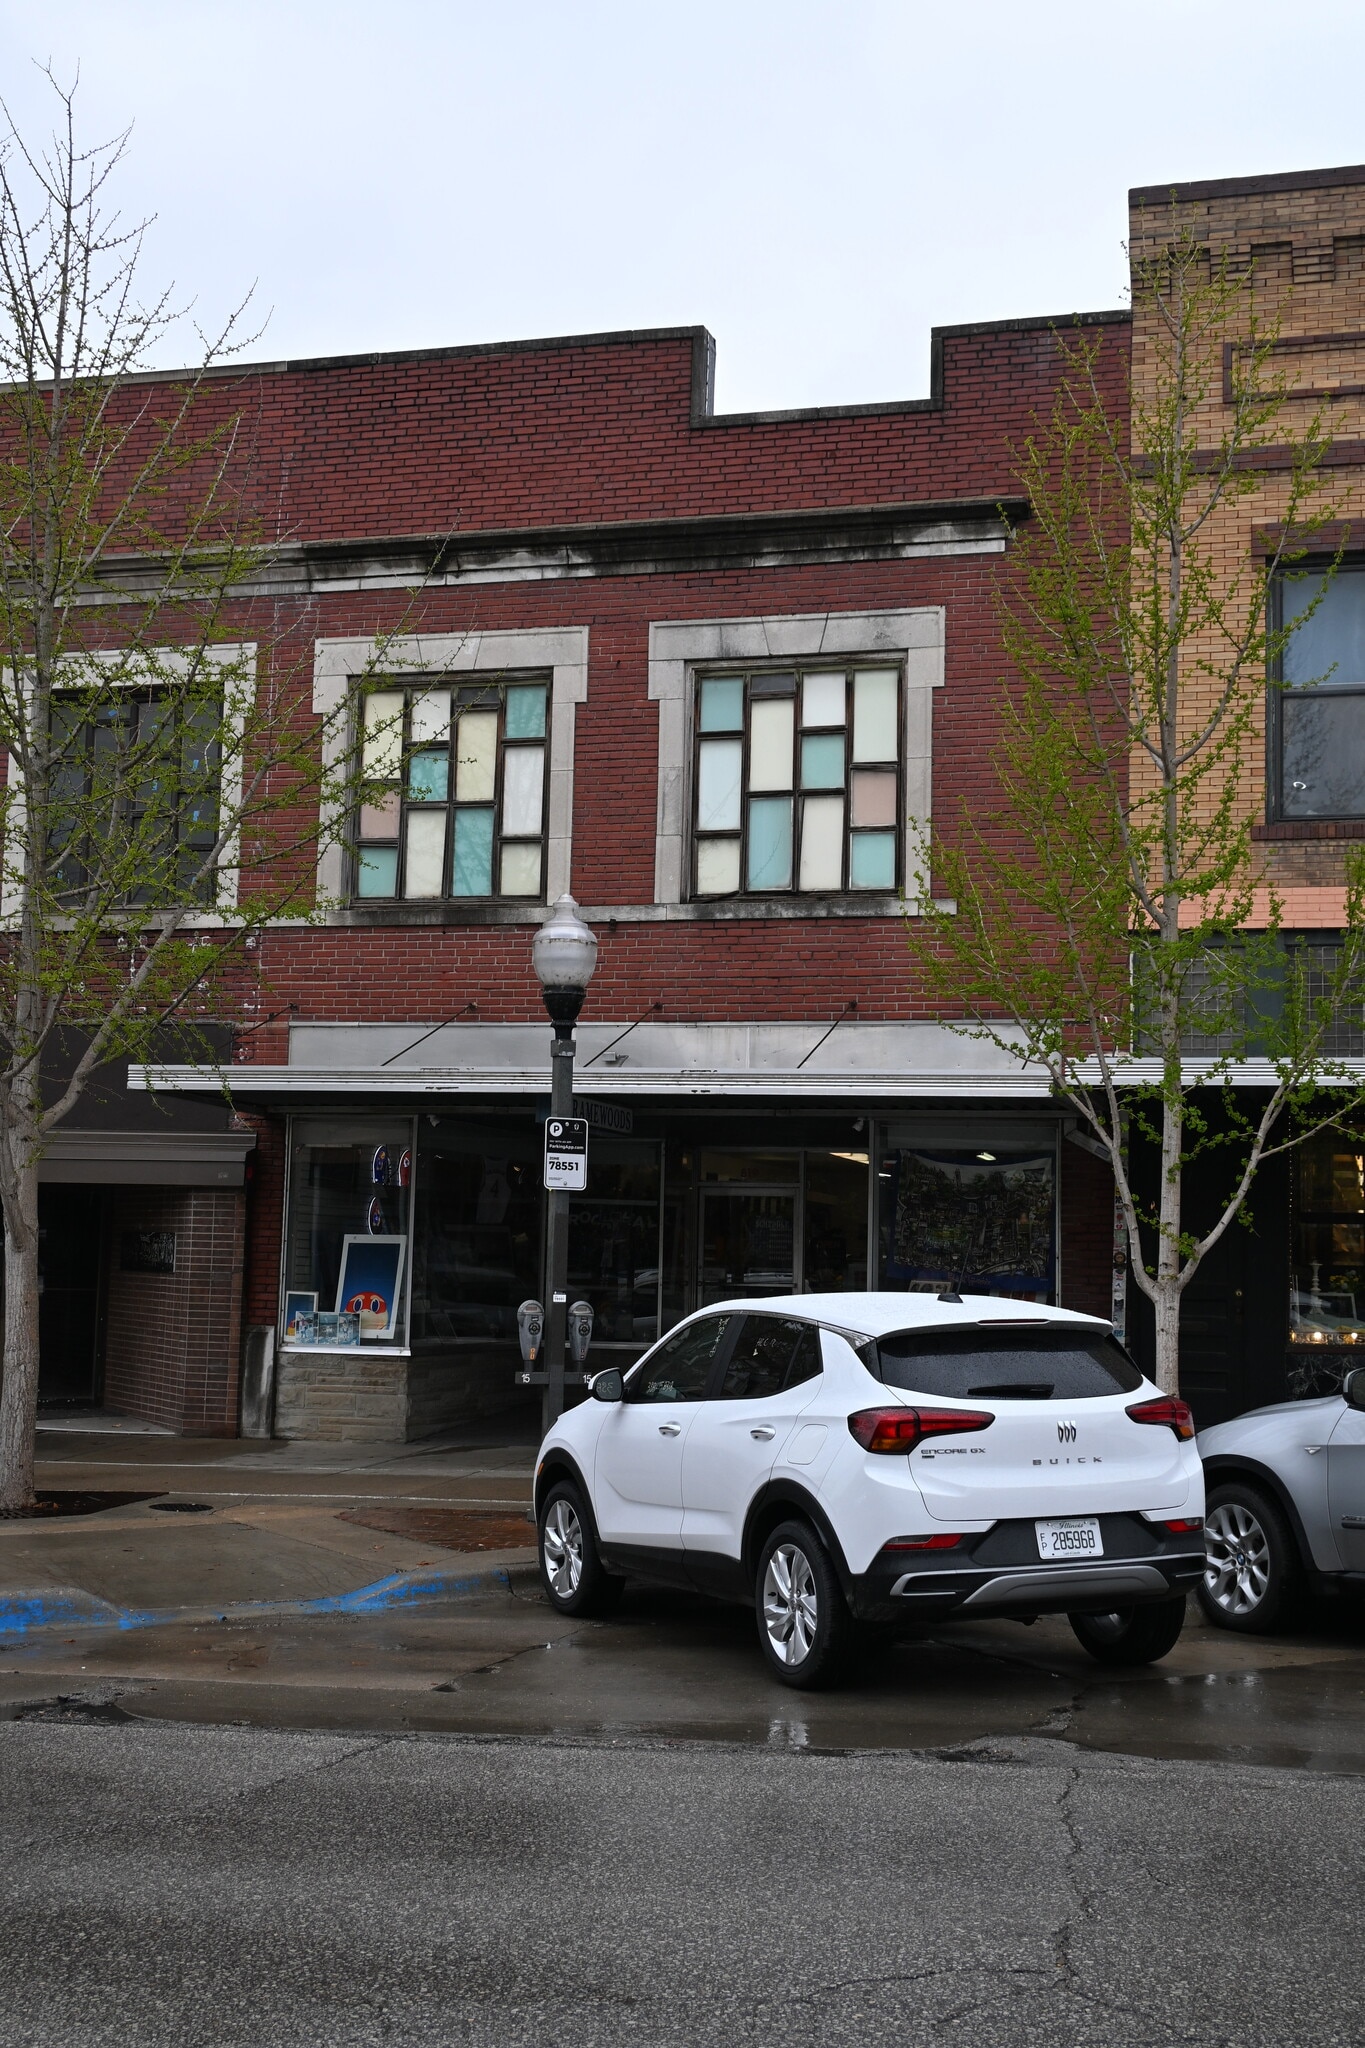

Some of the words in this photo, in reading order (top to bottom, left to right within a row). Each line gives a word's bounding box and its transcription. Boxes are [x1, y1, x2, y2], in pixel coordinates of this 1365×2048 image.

[572, 1099, 631, 1130] RAMEWOODS
[549, 1161, 579, 1171] 78551
[1032, 1456, 1102, 1466] BUICK
[1059, 1520, 1084, 1530] Illinois
[1051, 1529, 1096, 1551] 285968
